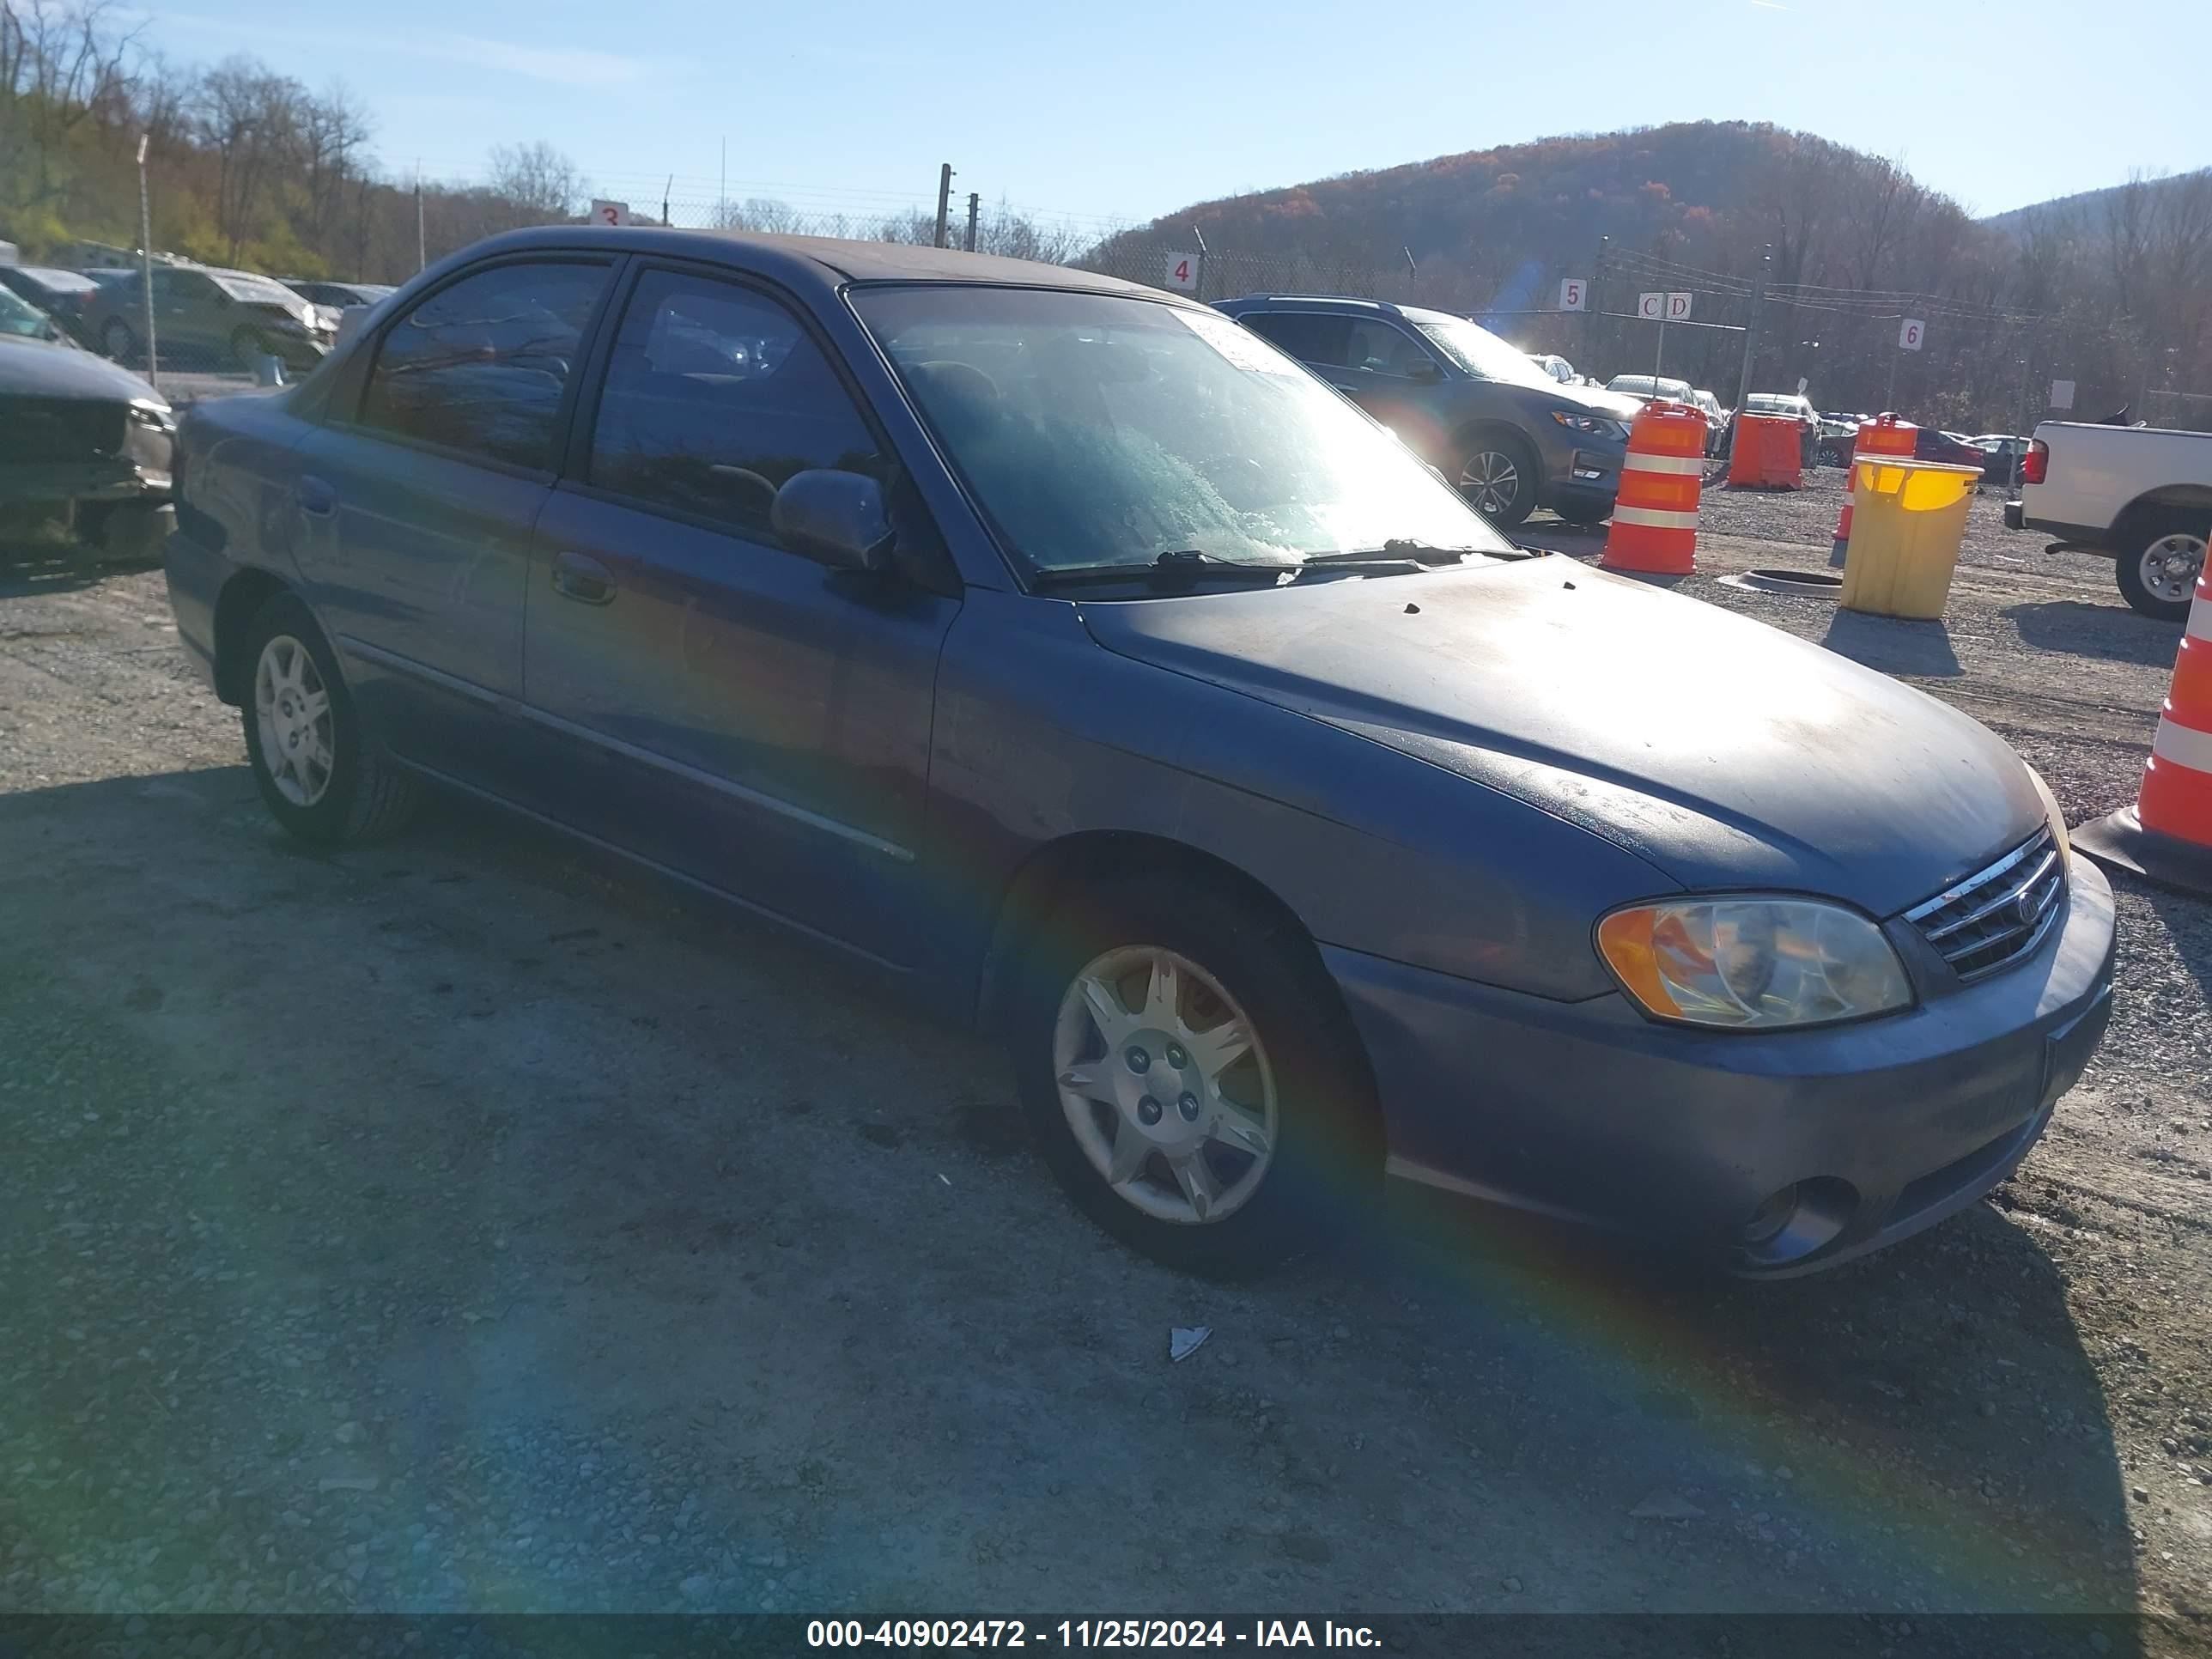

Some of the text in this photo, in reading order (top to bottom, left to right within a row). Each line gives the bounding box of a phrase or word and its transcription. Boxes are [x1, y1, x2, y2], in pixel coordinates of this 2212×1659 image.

[1175, 260, 1189, 283] 4
[1567, 285, 1579, 305] 5
[1644, 298, 1686, 315] C D
[1907, 325, 1918, 344] 6
